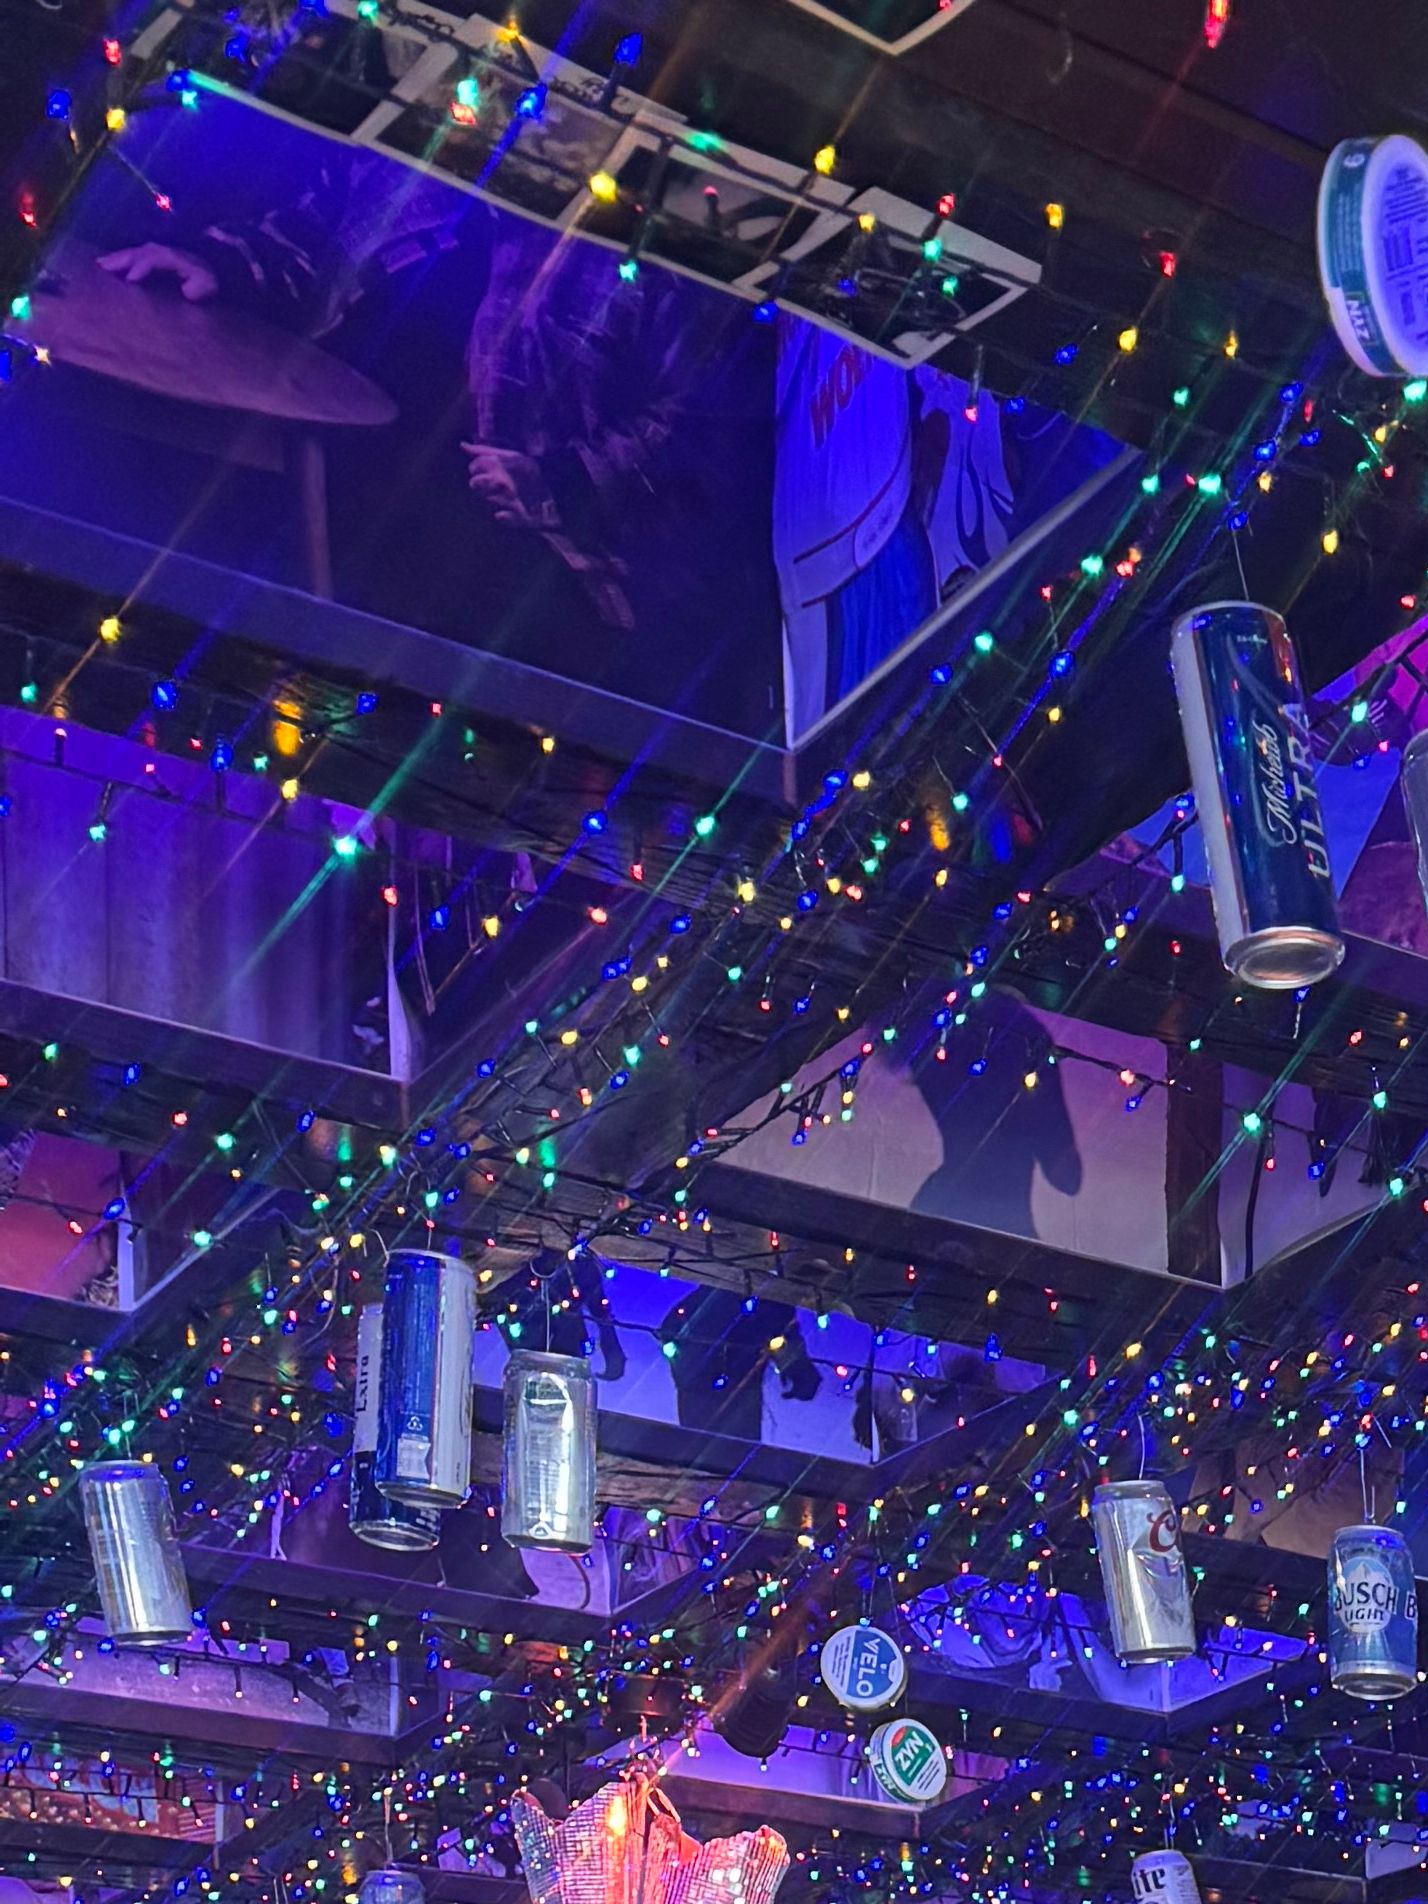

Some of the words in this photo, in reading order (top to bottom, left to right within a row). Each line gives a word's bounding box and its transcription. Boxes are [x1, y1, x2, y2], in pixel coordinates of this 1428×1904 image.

[1343, 299, 1371, 341] ZYN
[1253, 718, 1298, 847] Michelob
[856, 1638, 881, 1696] VELO
[895, 1731, 924, 1771] ZYN
